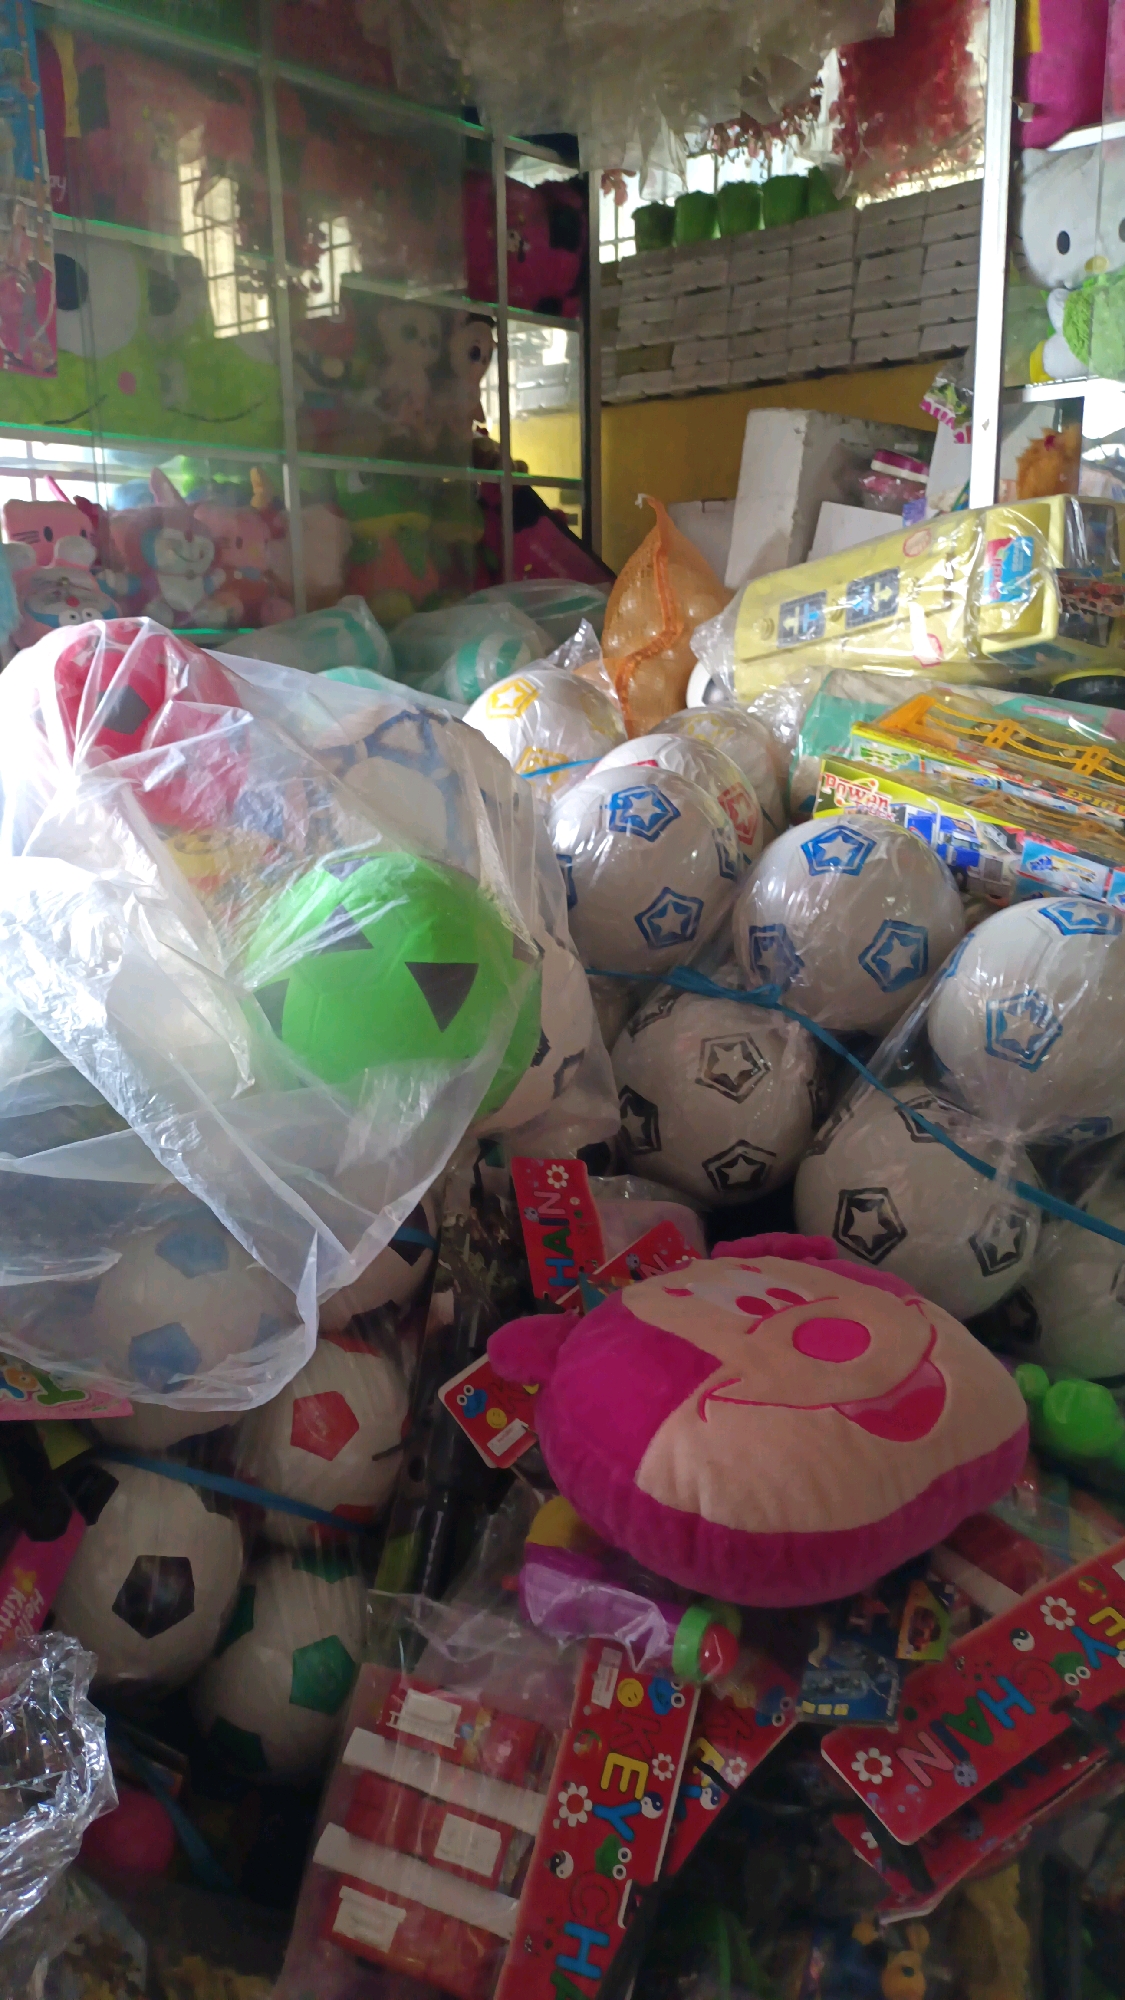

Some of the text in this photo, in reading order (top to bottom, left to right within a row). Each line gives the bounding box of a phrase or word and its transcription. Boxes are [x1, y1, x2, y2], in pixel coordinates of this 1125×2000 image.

[534, 1191, 577, 1287] HAIN
[592, 1709, 662, 1842] KEY
[896, 1656, 1064, 1788] CHAIN
